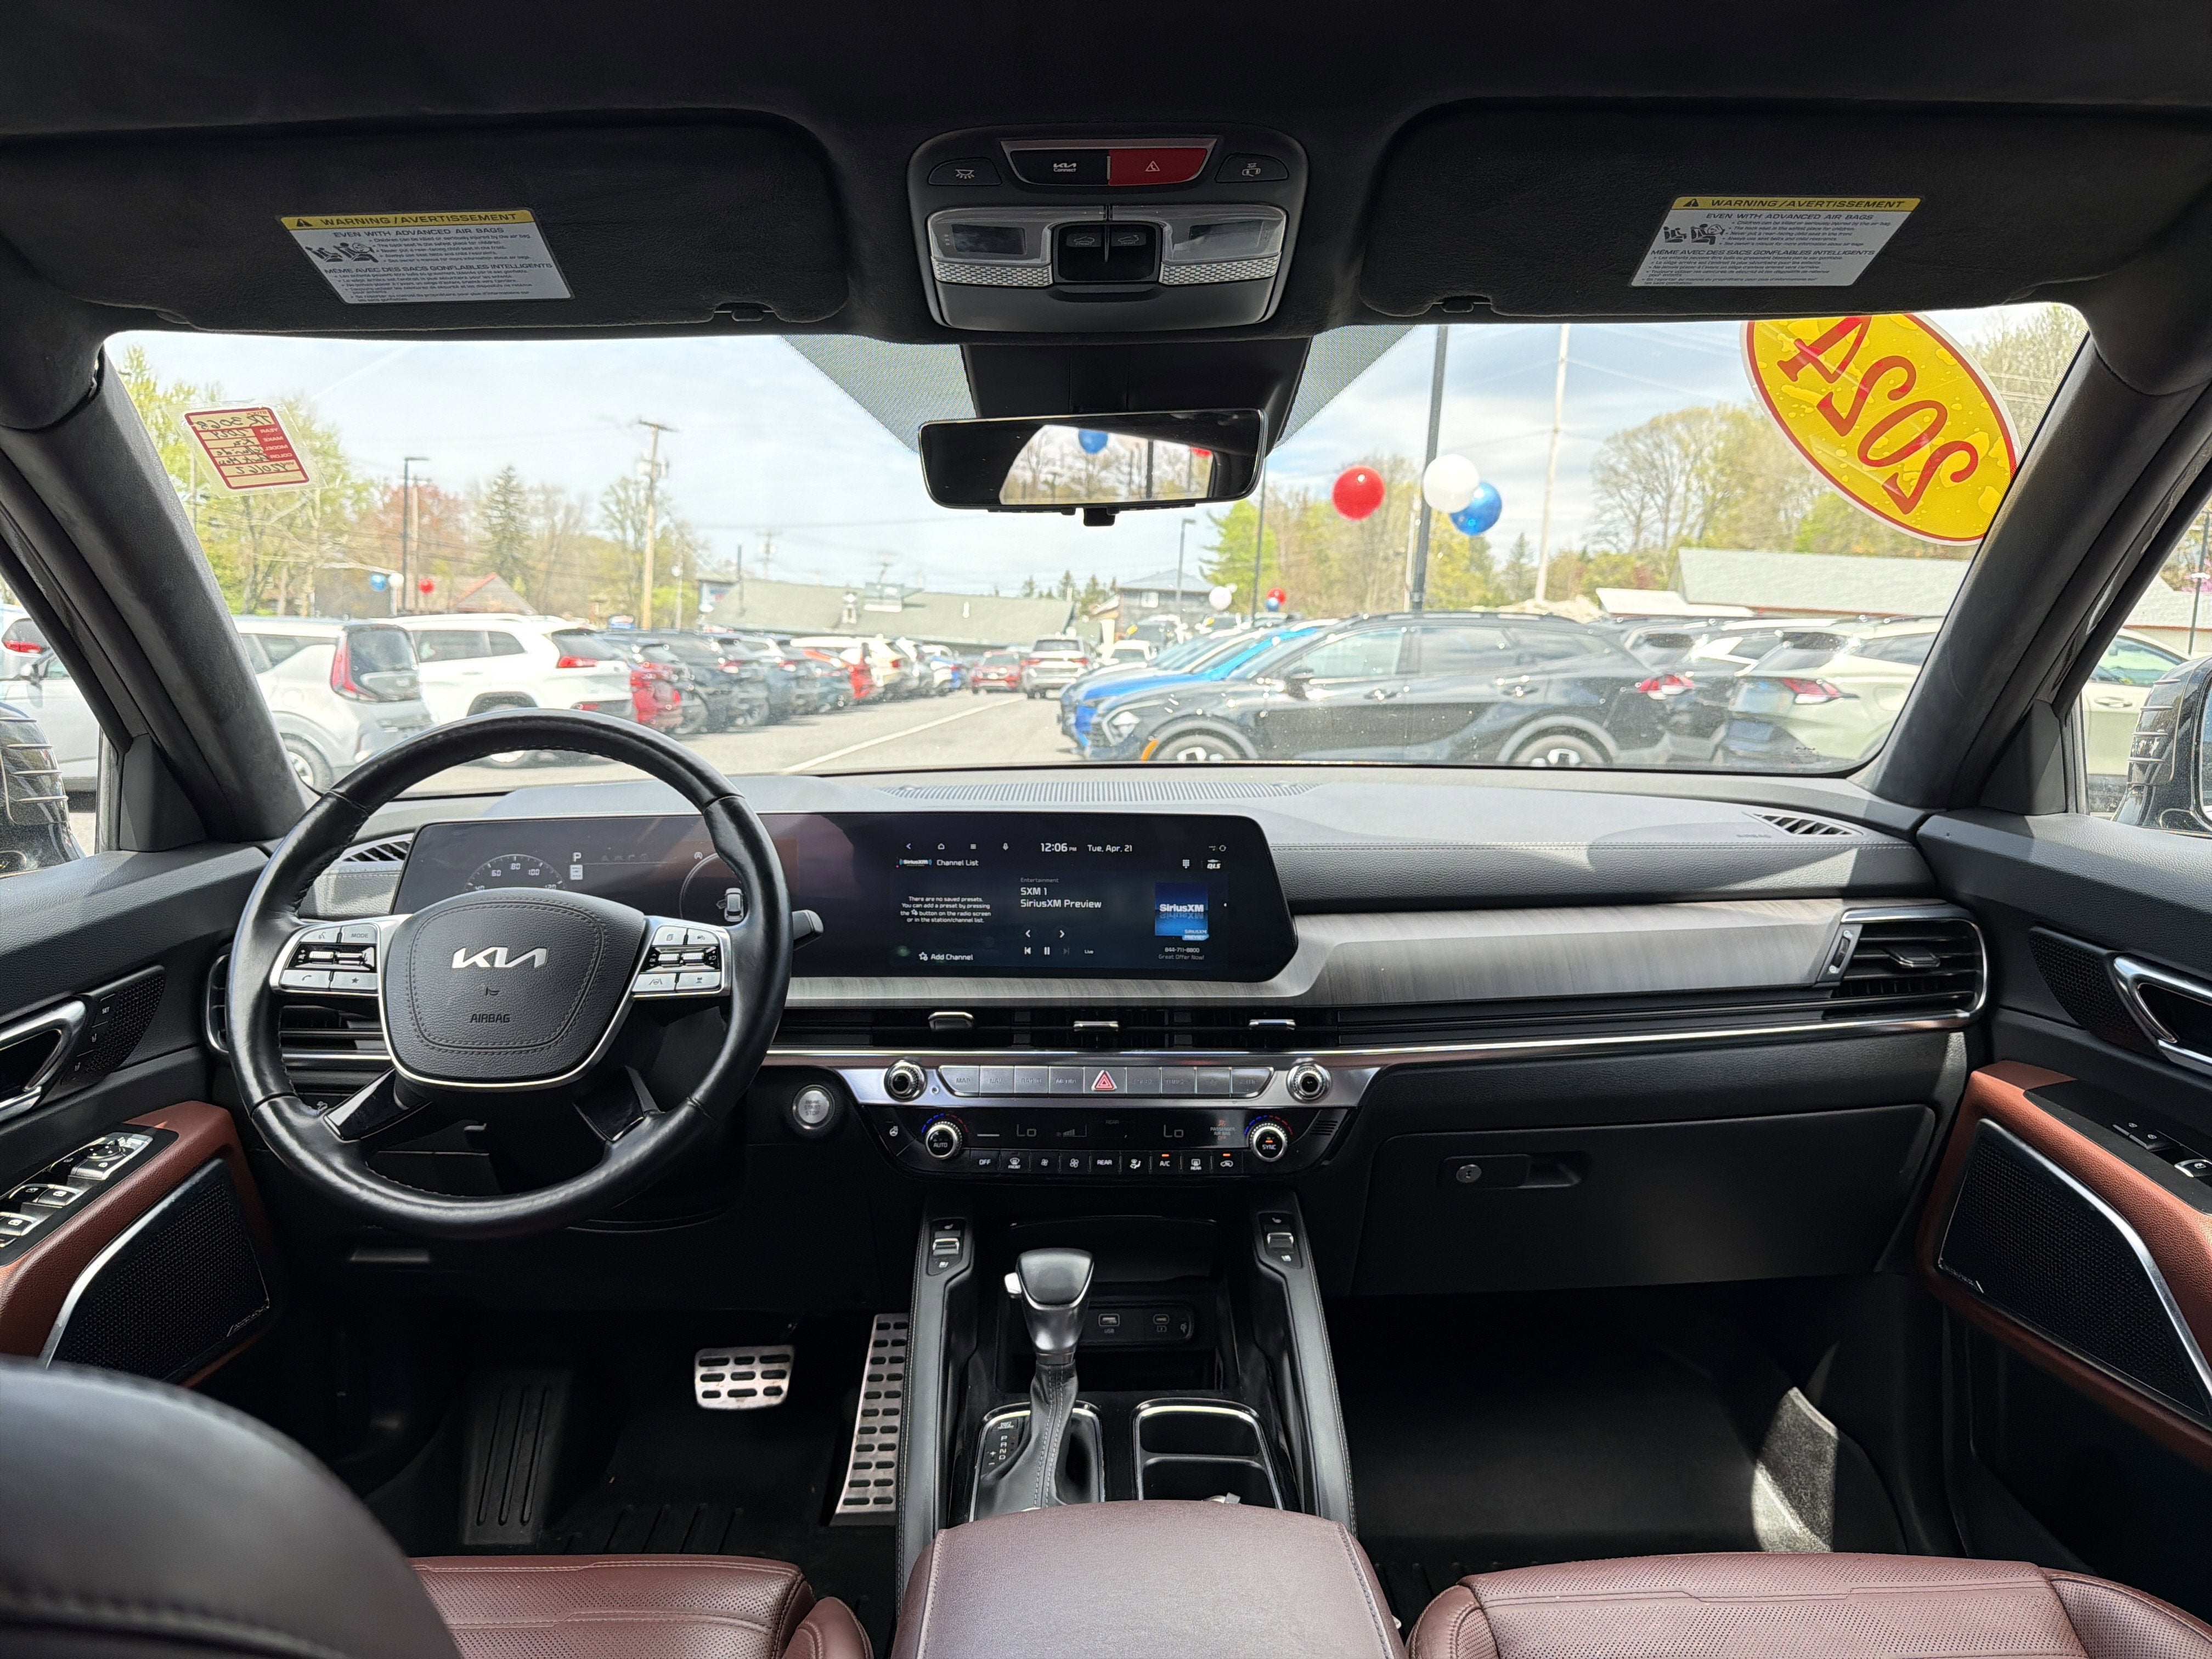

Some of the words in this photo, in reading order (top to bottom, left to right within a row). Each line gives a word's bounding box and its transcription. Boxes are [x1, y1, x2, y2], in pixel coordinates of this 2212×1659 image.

[1711, 199, 1779, 207] WARNING
[319, 217, 391, 226] WARNING
[400, 213, 517, 223] AVERTISSEMENT
[1040, 843, 1068, 852] 12:06
[1087, 844, 1104, 853] Tue,
[1105, 844, 1122, 853] Apr.
[572, 852, 582, 862] P
[1020, 887, 1041, 895] SXM
[1043, 887, 1047, 895] 1
[1020, 899, 1062, 908] SiriusXM
[1064, 899, 1102, 908] Preview
[1159, 904, 1204, 913] SiriusXM
[452, 945, 548, 969] KIA
[102, 1006, 110, 1014] SET
[470, 1013, 510, 1023] AIRBAG
